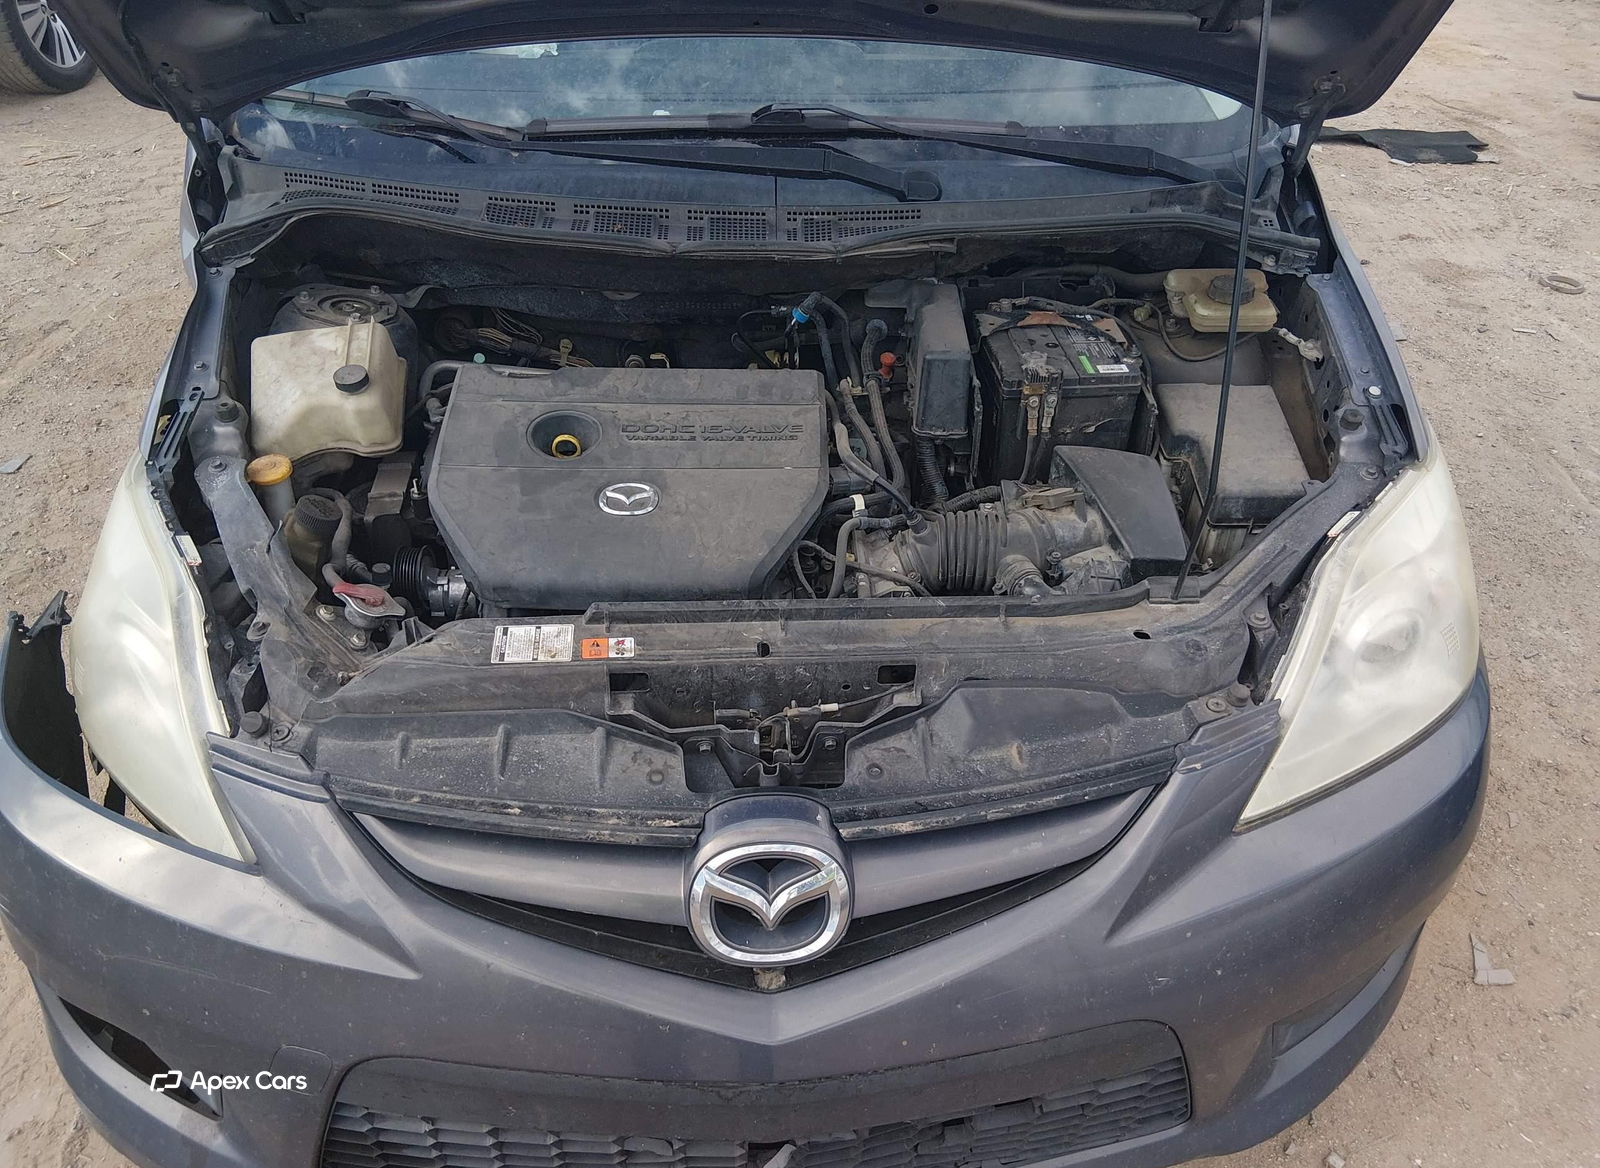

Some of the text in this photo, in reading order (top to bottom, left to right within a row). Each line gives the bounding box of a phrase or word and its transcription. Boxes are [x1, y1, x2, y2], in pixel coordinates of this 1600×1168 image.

[621, 423, 804, 434] DOHC 16-VALVE
[702, 434, 745, 442] VALVE
